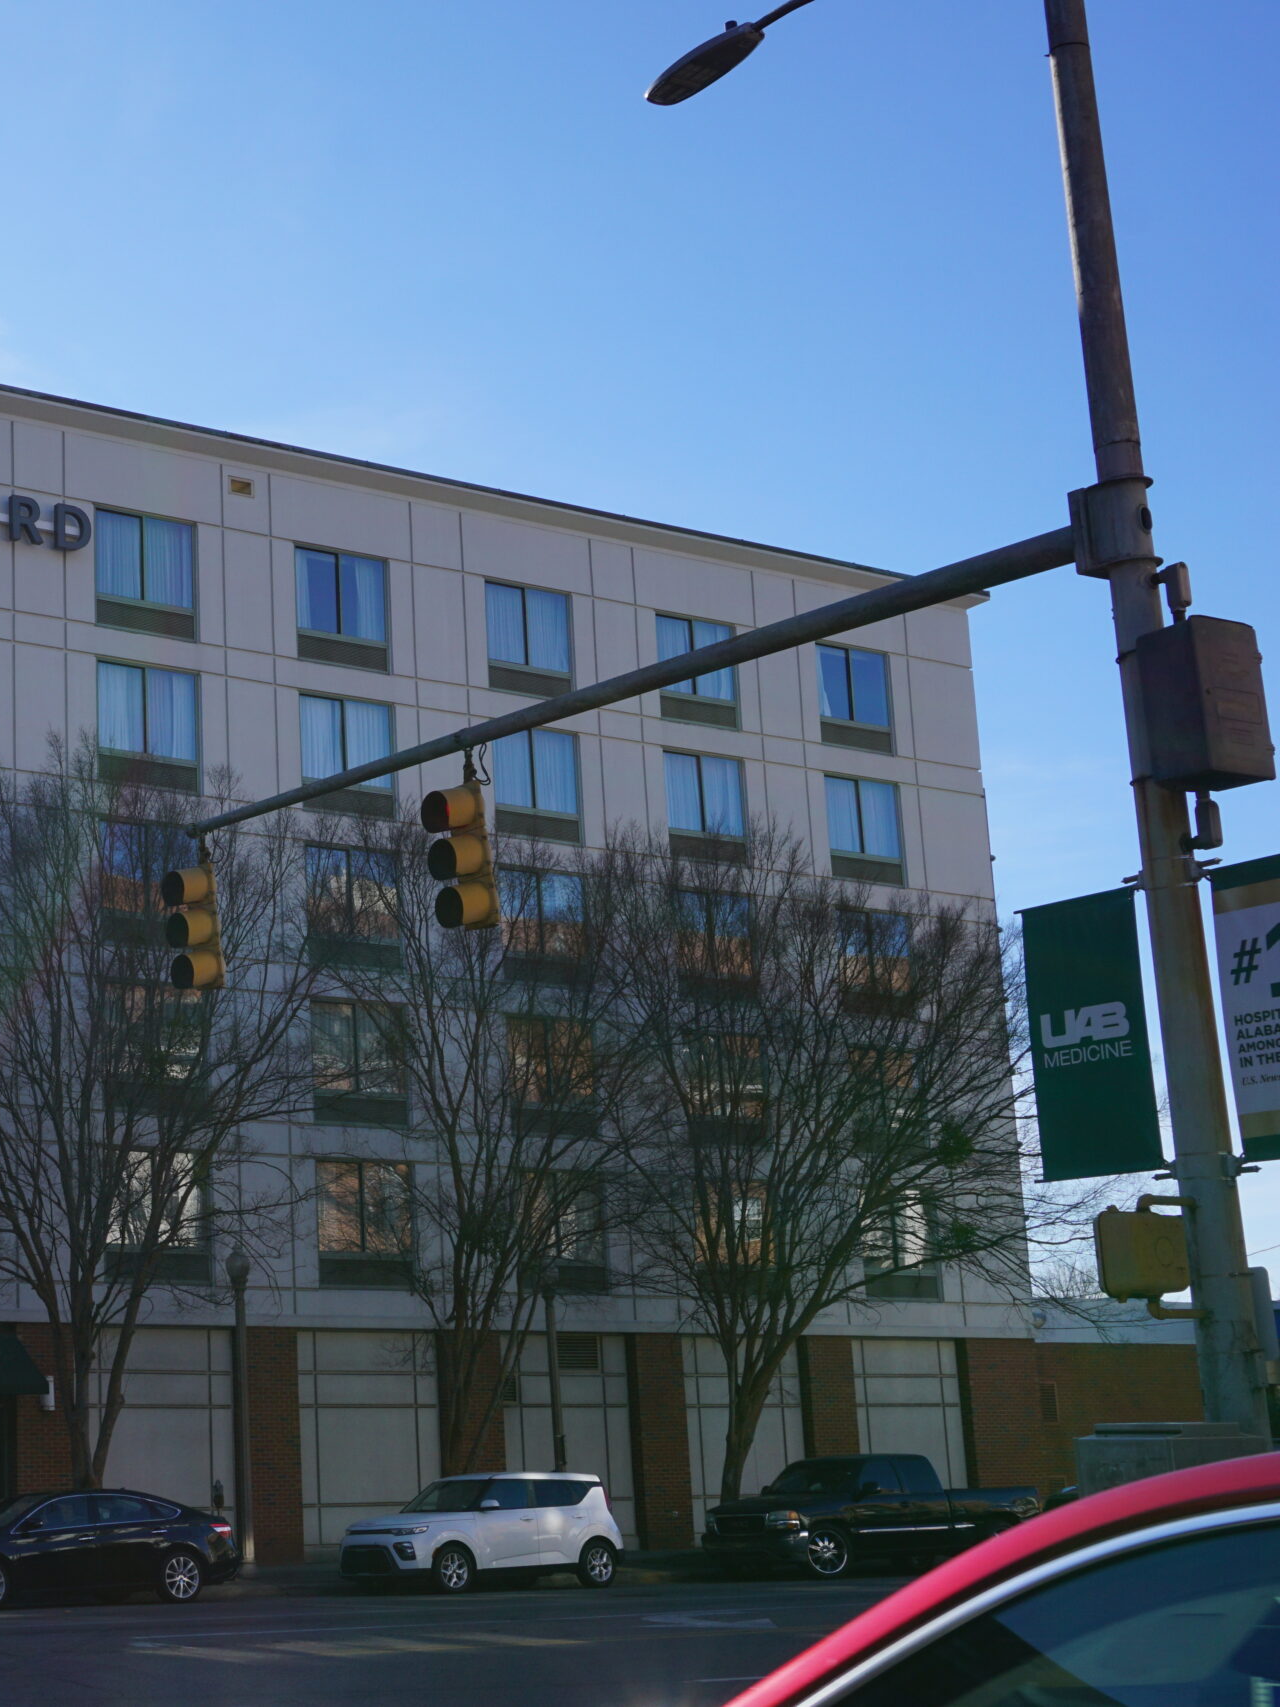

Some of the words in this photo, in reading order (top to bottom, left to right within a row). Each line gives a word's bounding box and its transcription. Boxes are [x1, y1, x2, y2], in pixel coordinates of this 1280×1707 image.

[1040, 1001, 1130, 1049] UAB
[1043, 1040, 1133, 1068] MEDICINE
[1240, 1055, 1253, 1068] IN
